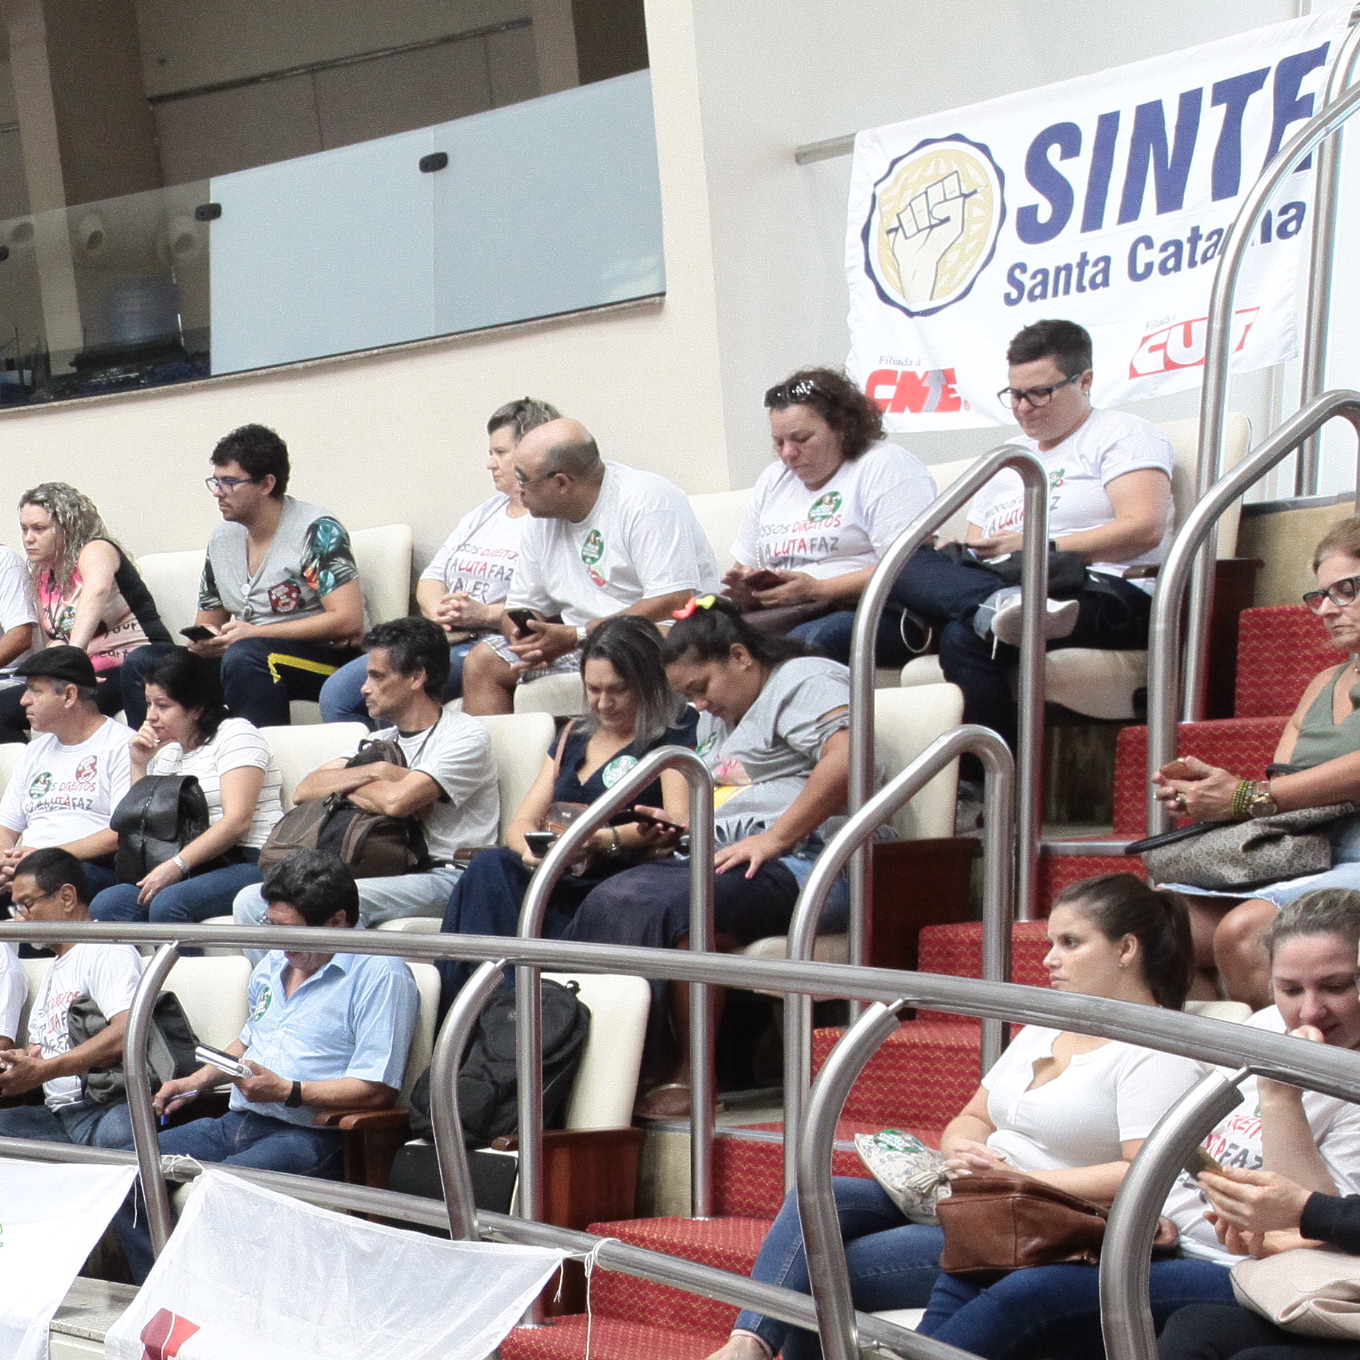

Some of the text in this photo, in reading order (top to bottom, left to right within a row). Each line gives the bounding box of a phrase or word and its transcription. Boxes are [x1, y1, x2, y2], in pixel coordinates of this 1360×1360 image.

[1015, 40, 1332, 246] SINTE
[1003, 199, 1307, 307] Santa Catana
[458, 561, 487, 577] LUTA
[488, 564, 514, 580] FAZ
[773, 537, 806, 557] LUTA
[809, 536, 839, 553] FAZ
